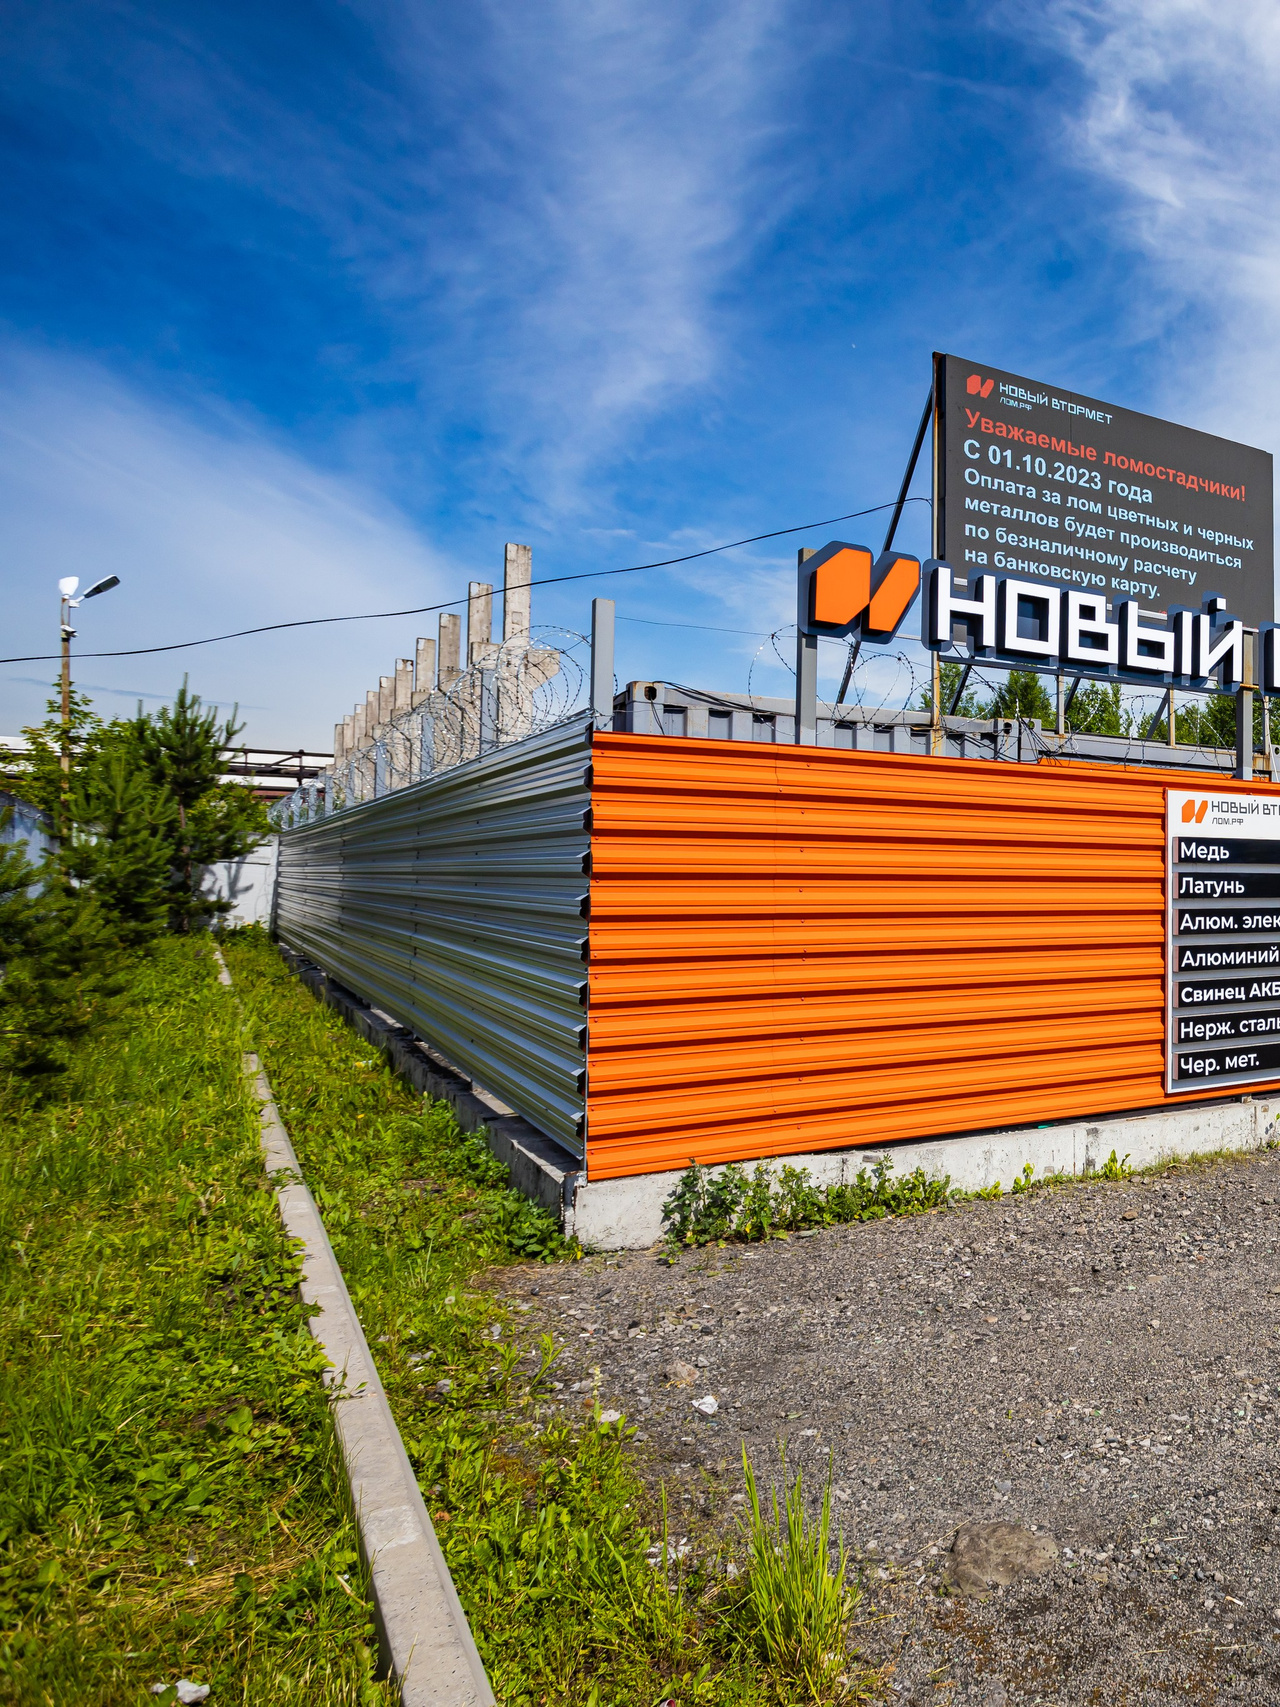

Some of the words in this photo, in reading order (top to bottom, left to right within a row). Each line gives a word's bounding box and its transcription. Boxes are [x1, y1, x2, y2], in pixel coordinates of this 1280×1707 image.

[1000, 382, 1048, 406] НОВЫЙ
[1051, 398, 1113, 424] ВТОРМЕТ
[1000, 397, 1032, 411] ЛОМ.РФ
[965, 408, 1097, 461] Уважаемые
[1103, 452, 1246, 501] ломостадчики!
[963, 439, 981, 459] С
[988, 445, 1102, 490] 01.10.2023
[1108, 478, 1153, 504] года
[964, 468, 1037, 500] Оплата
[1042, 488, 1062, 503] за
[1066, 495, 1102, 514] лом
[1107, 504, 1179, 533] цветных
[1183, 521, 1193, 536] и
[1197, 527, 1254, 551] черных
[964, 497, 1059, 529] металлов
[1064, 516, 1115, 541] будет
[1120, 531, 1242, 570] производиться
[964, 523, 989, 540] по
[995, 526, 1128, 571] безналичному
[1133, 558, 1197, 585] расчету
[964, 548, 988, 565] на
[994, 551, 1106, 587] банковскую
[1111, 576, 1161, 600] карту.
[935, 565, 1243, 692] НОВЫЙ
[1211, 800, 1259, 815] НОВЫЙ
[1212, 817, 1244, 826] ЛОМ.РФ
[1180, 842, 1230, 861] Медь
[1180, 877, 1245, 898] Латунь
[1180, 914, 1238, 930] Алюм.
[1181, 946, 1280, 967] Алюминий
[1181, 986, 1246, 1004] Свинец
[1180, 1021, 1235, 1040] Нерж.
[1180, 1057, 1220, 1075] Чер.
[1225, 1053, 1260, 1069] мет.
